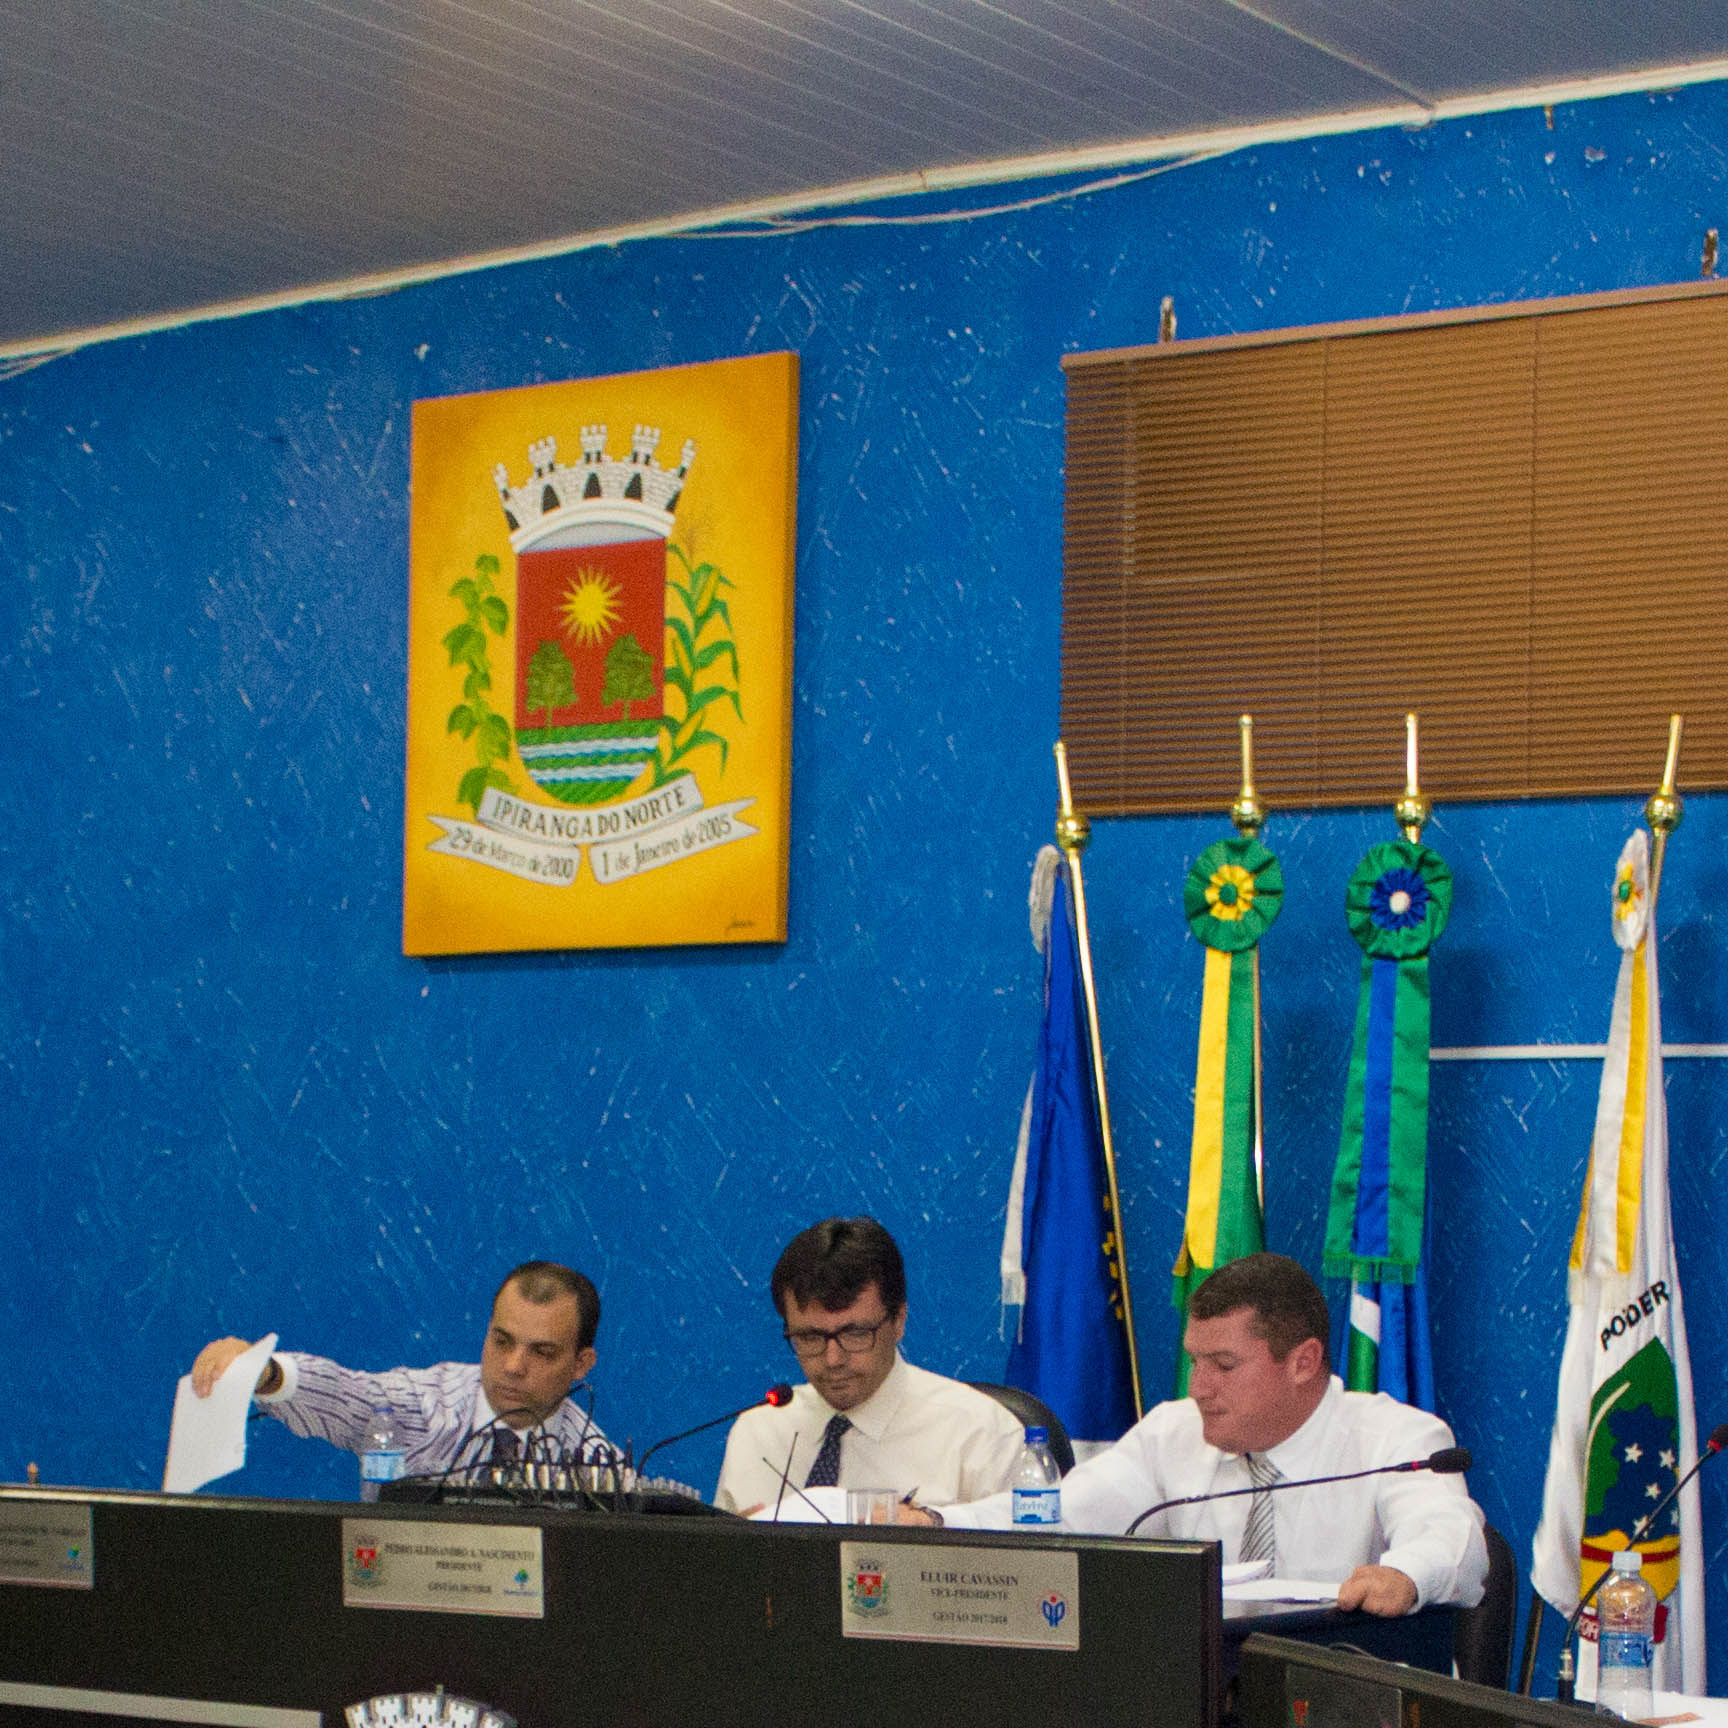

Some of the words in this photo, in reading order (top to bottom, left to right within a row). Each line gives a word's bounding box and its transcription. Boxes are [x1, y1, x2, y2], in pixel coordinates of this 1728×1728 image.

[449, 826, 472, 849] 29
[493, 796, 593, 838] IPIRANGA
[598, 811, 620, 836] DO
[624, 785, 686, 829] NORTE
[602, 851, 609, 877] 1
[697, 812, 732, 843] 2005
[1600, 1280, 1670, 1350] PODER
[920, 1571, 958, 1585] ELUIR
[961, 1573, 1019, 1586] CAVASSIN
